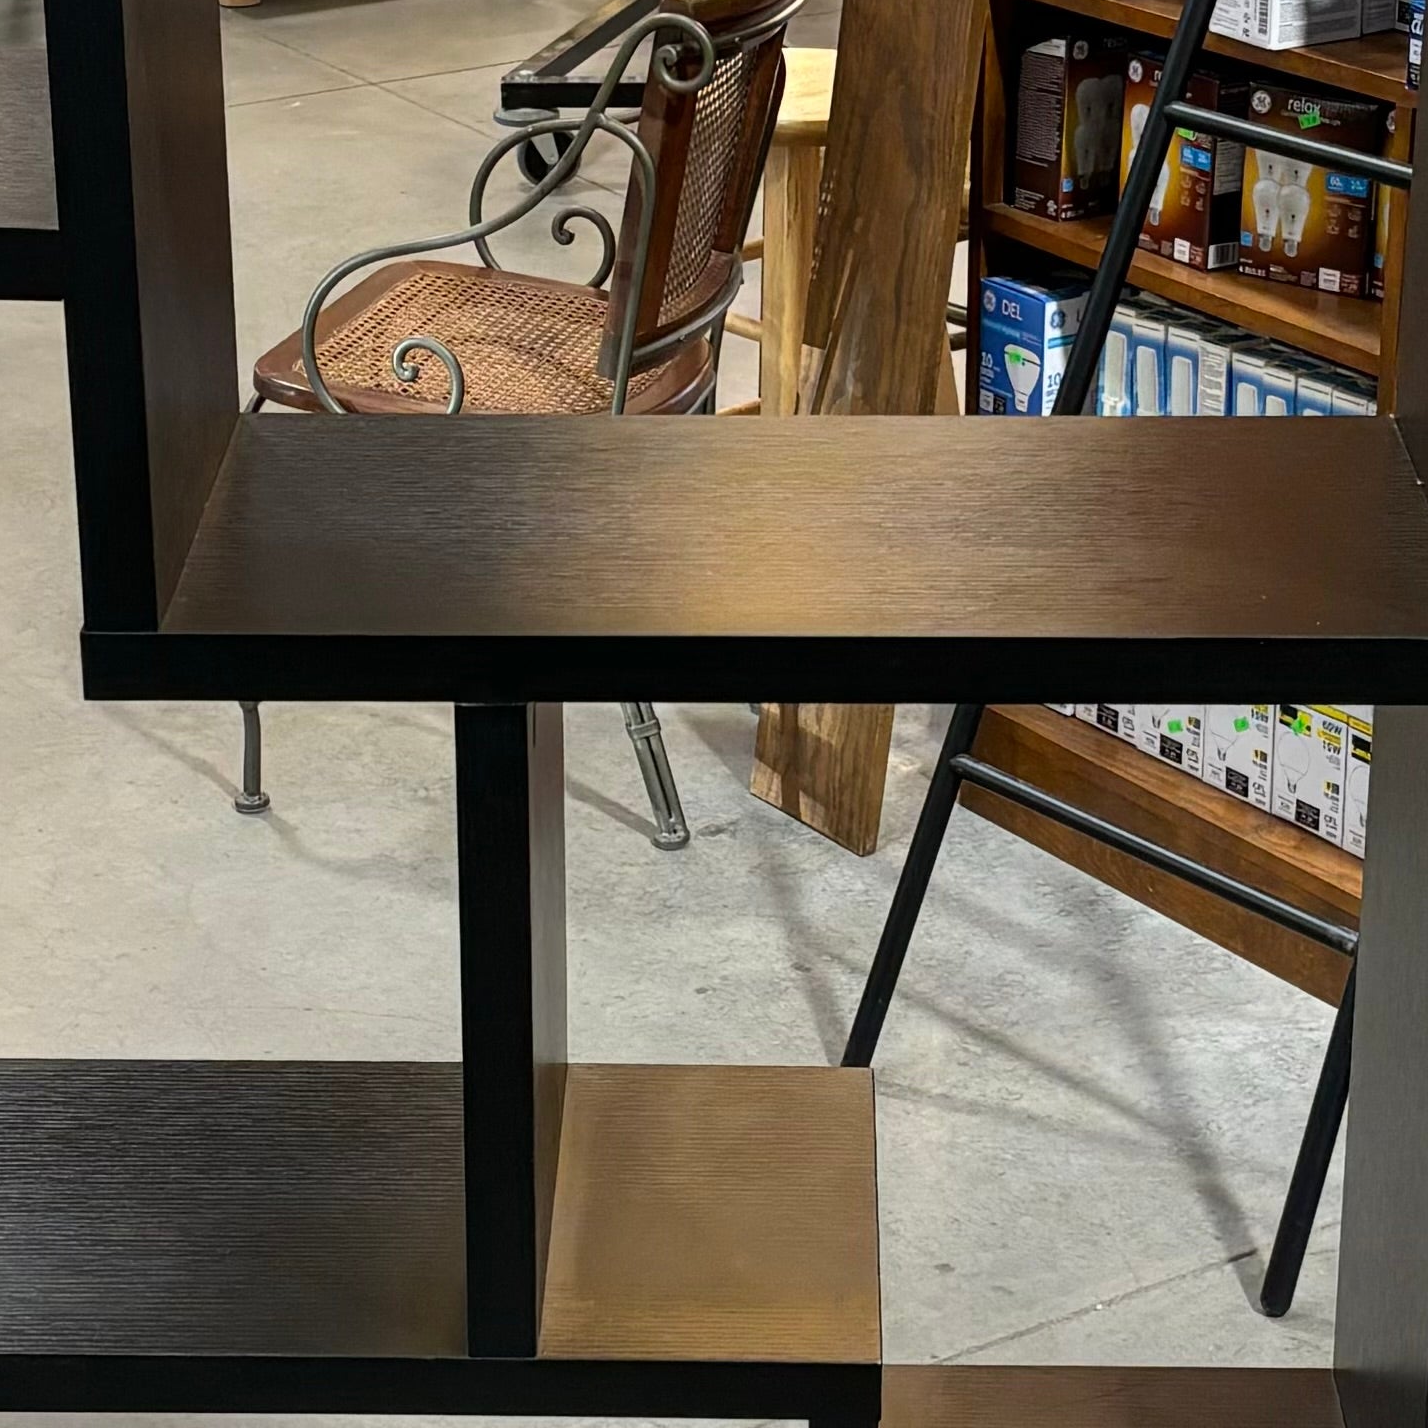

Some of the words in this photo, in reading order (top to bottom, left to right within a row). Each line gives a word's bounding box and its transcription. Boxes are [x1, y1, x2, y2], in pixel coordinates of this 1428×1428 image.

[1002, 299, 1023, 321] DEL
[981, 351, 993, 368] 10
[1047, 372, 1062, 388] 10
